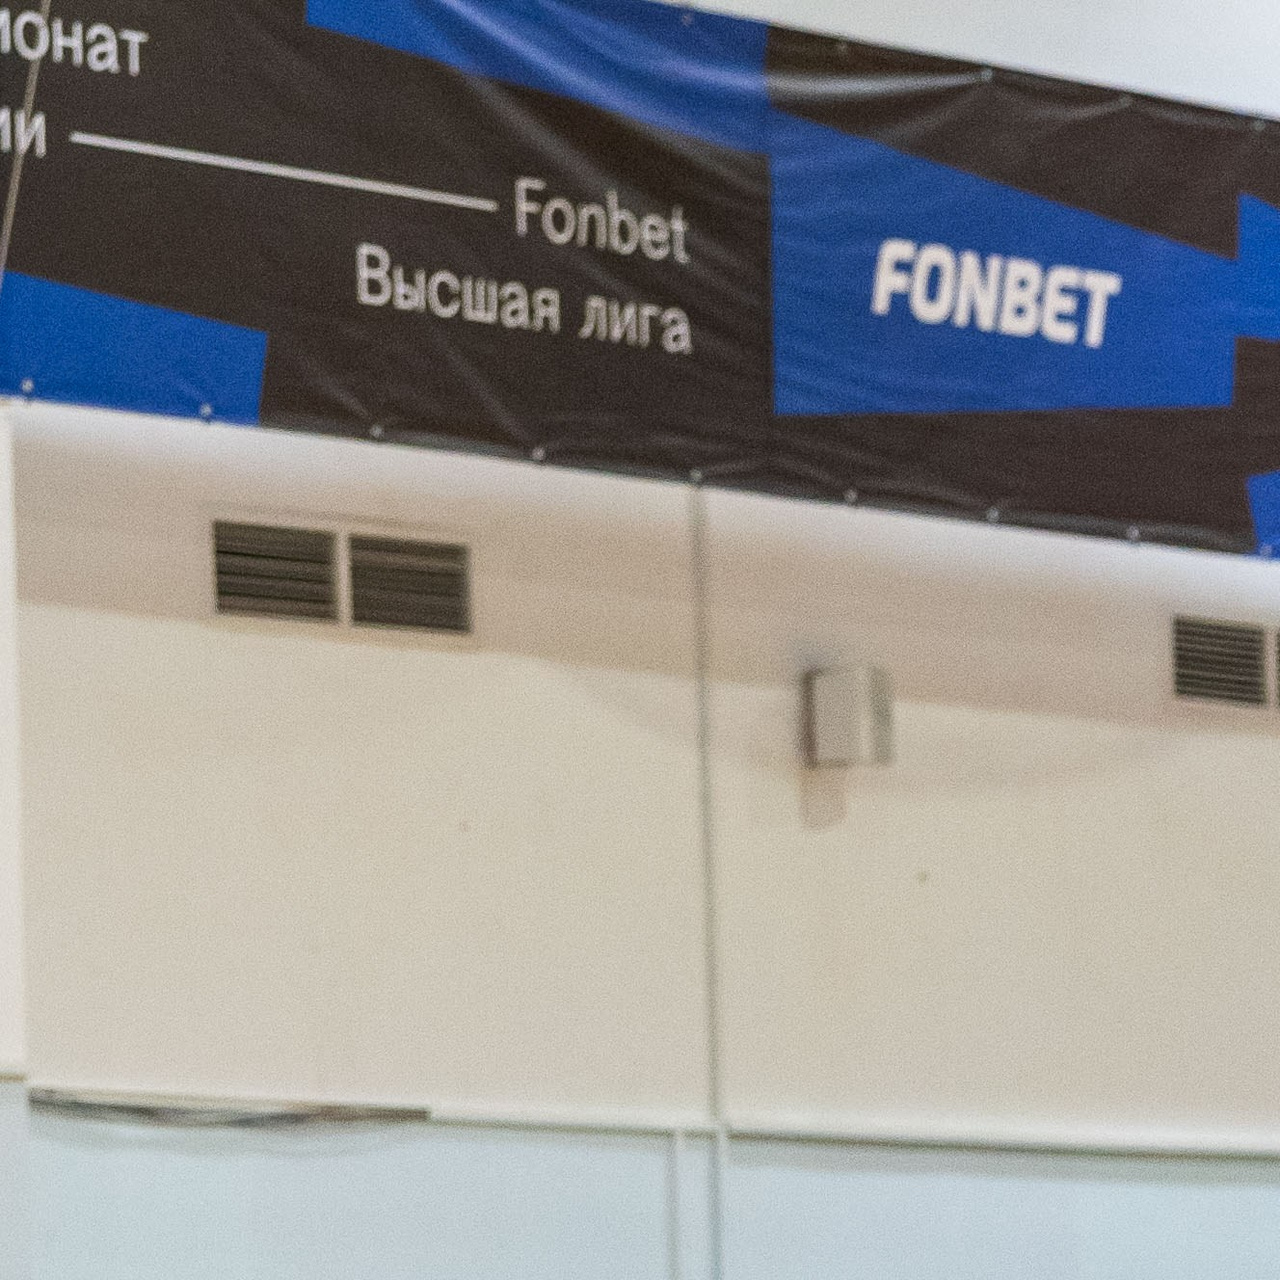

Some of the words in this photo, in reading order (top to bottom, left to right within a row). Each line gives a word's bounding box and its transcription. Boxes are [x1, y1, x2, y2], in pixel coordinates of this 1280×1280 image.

[514, 176, 691, 264] Fonbet
[355, 241, 561, 334] Высшая
[578, 294, 693, 355] лига
[869, 236, 1123, 348] FONBET
